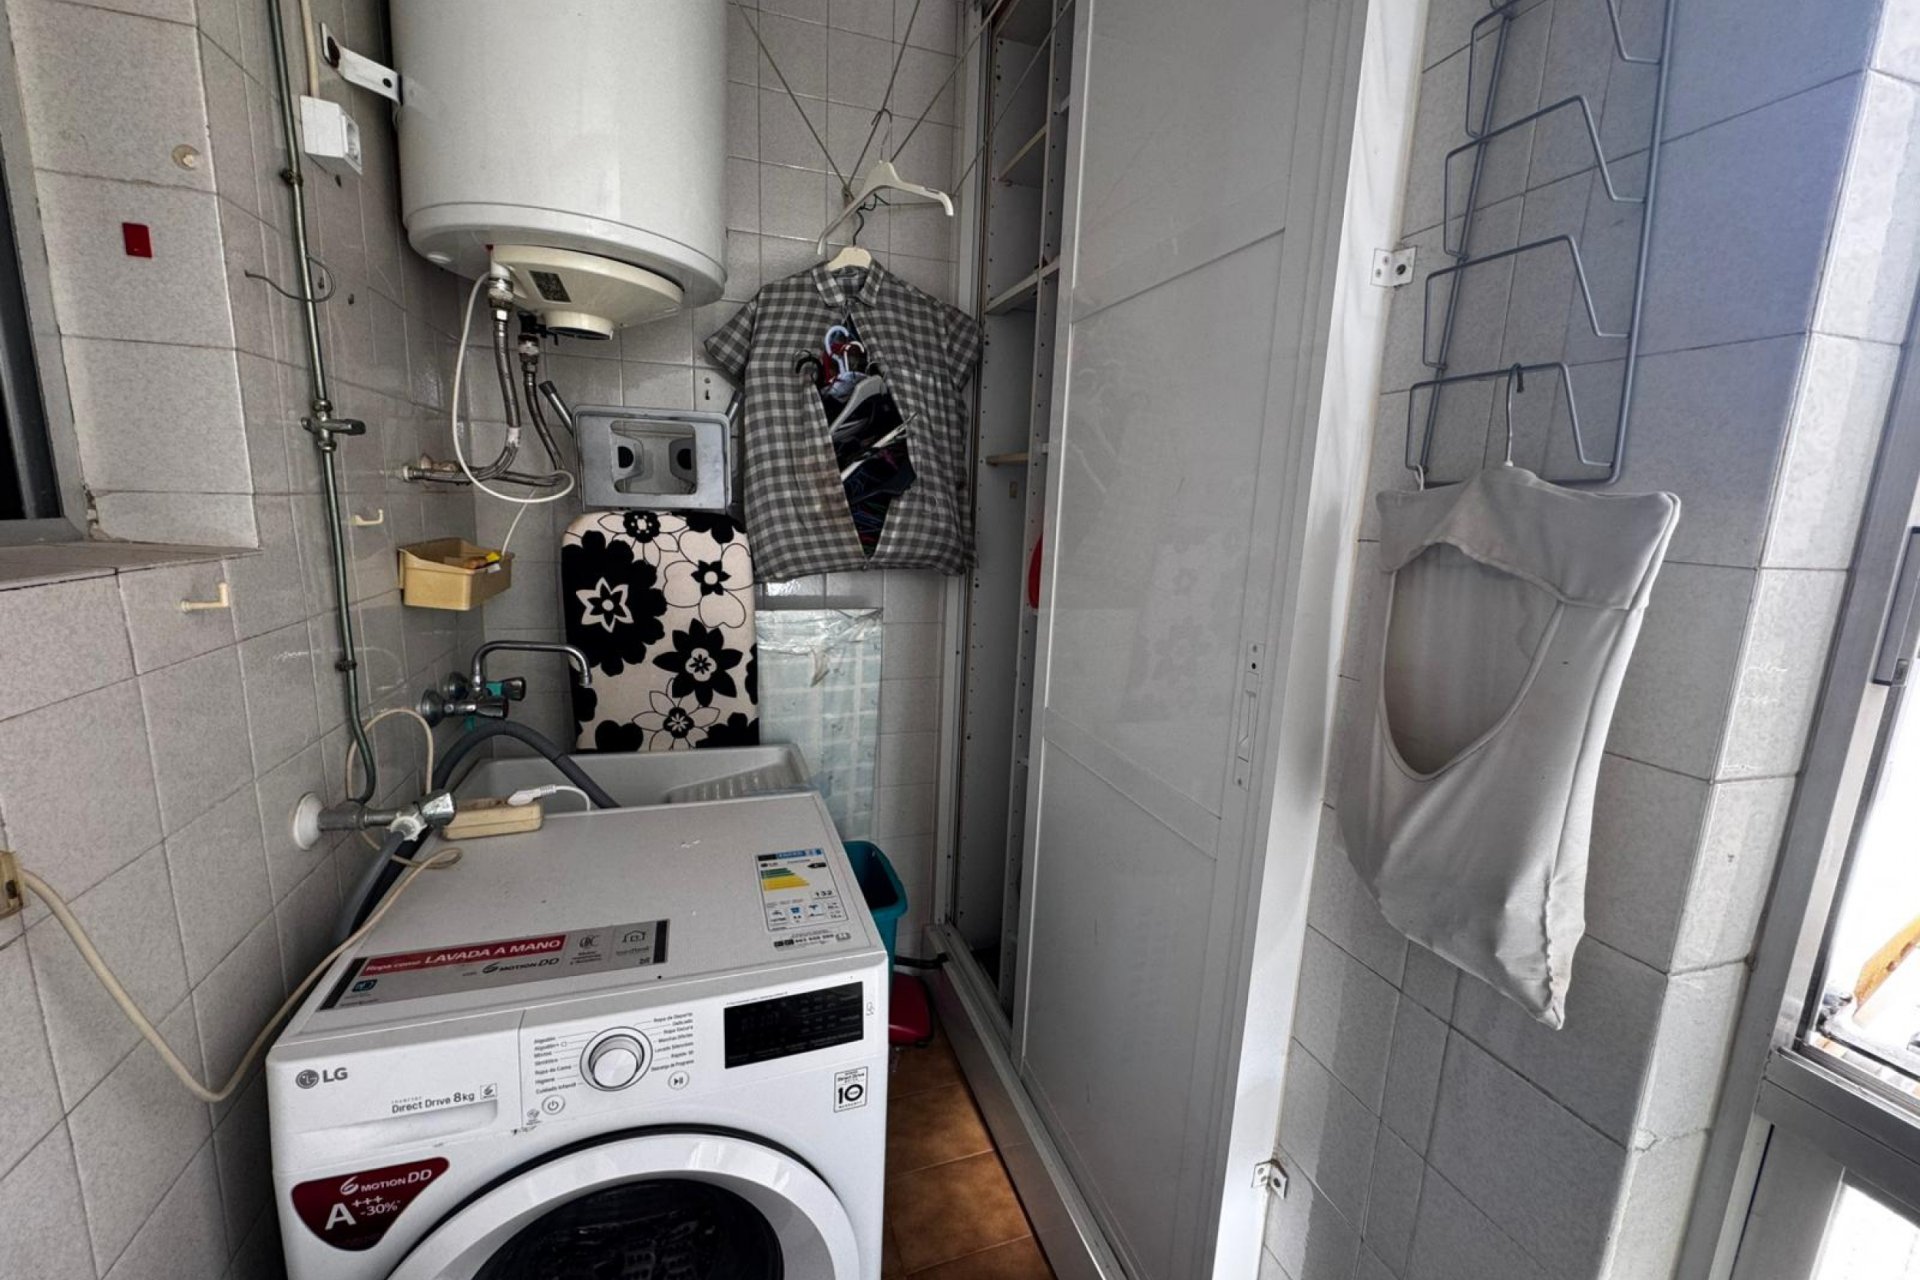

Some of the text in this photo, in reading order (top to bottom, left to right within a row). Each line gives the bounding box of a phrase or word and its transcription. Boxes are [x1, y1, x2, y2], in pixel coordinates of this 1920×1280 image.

[425, 948, 490, 964] LAVADA
[494, 946, 506, 954] A
[509, 939, 562, 953] MANO
[322, 1067, 348, 1083] LG
[838, 1083, 864, 1105] 10
[391, 1101, 422, 1114] Direct
[425, 1098, 451, 1110] Drive
